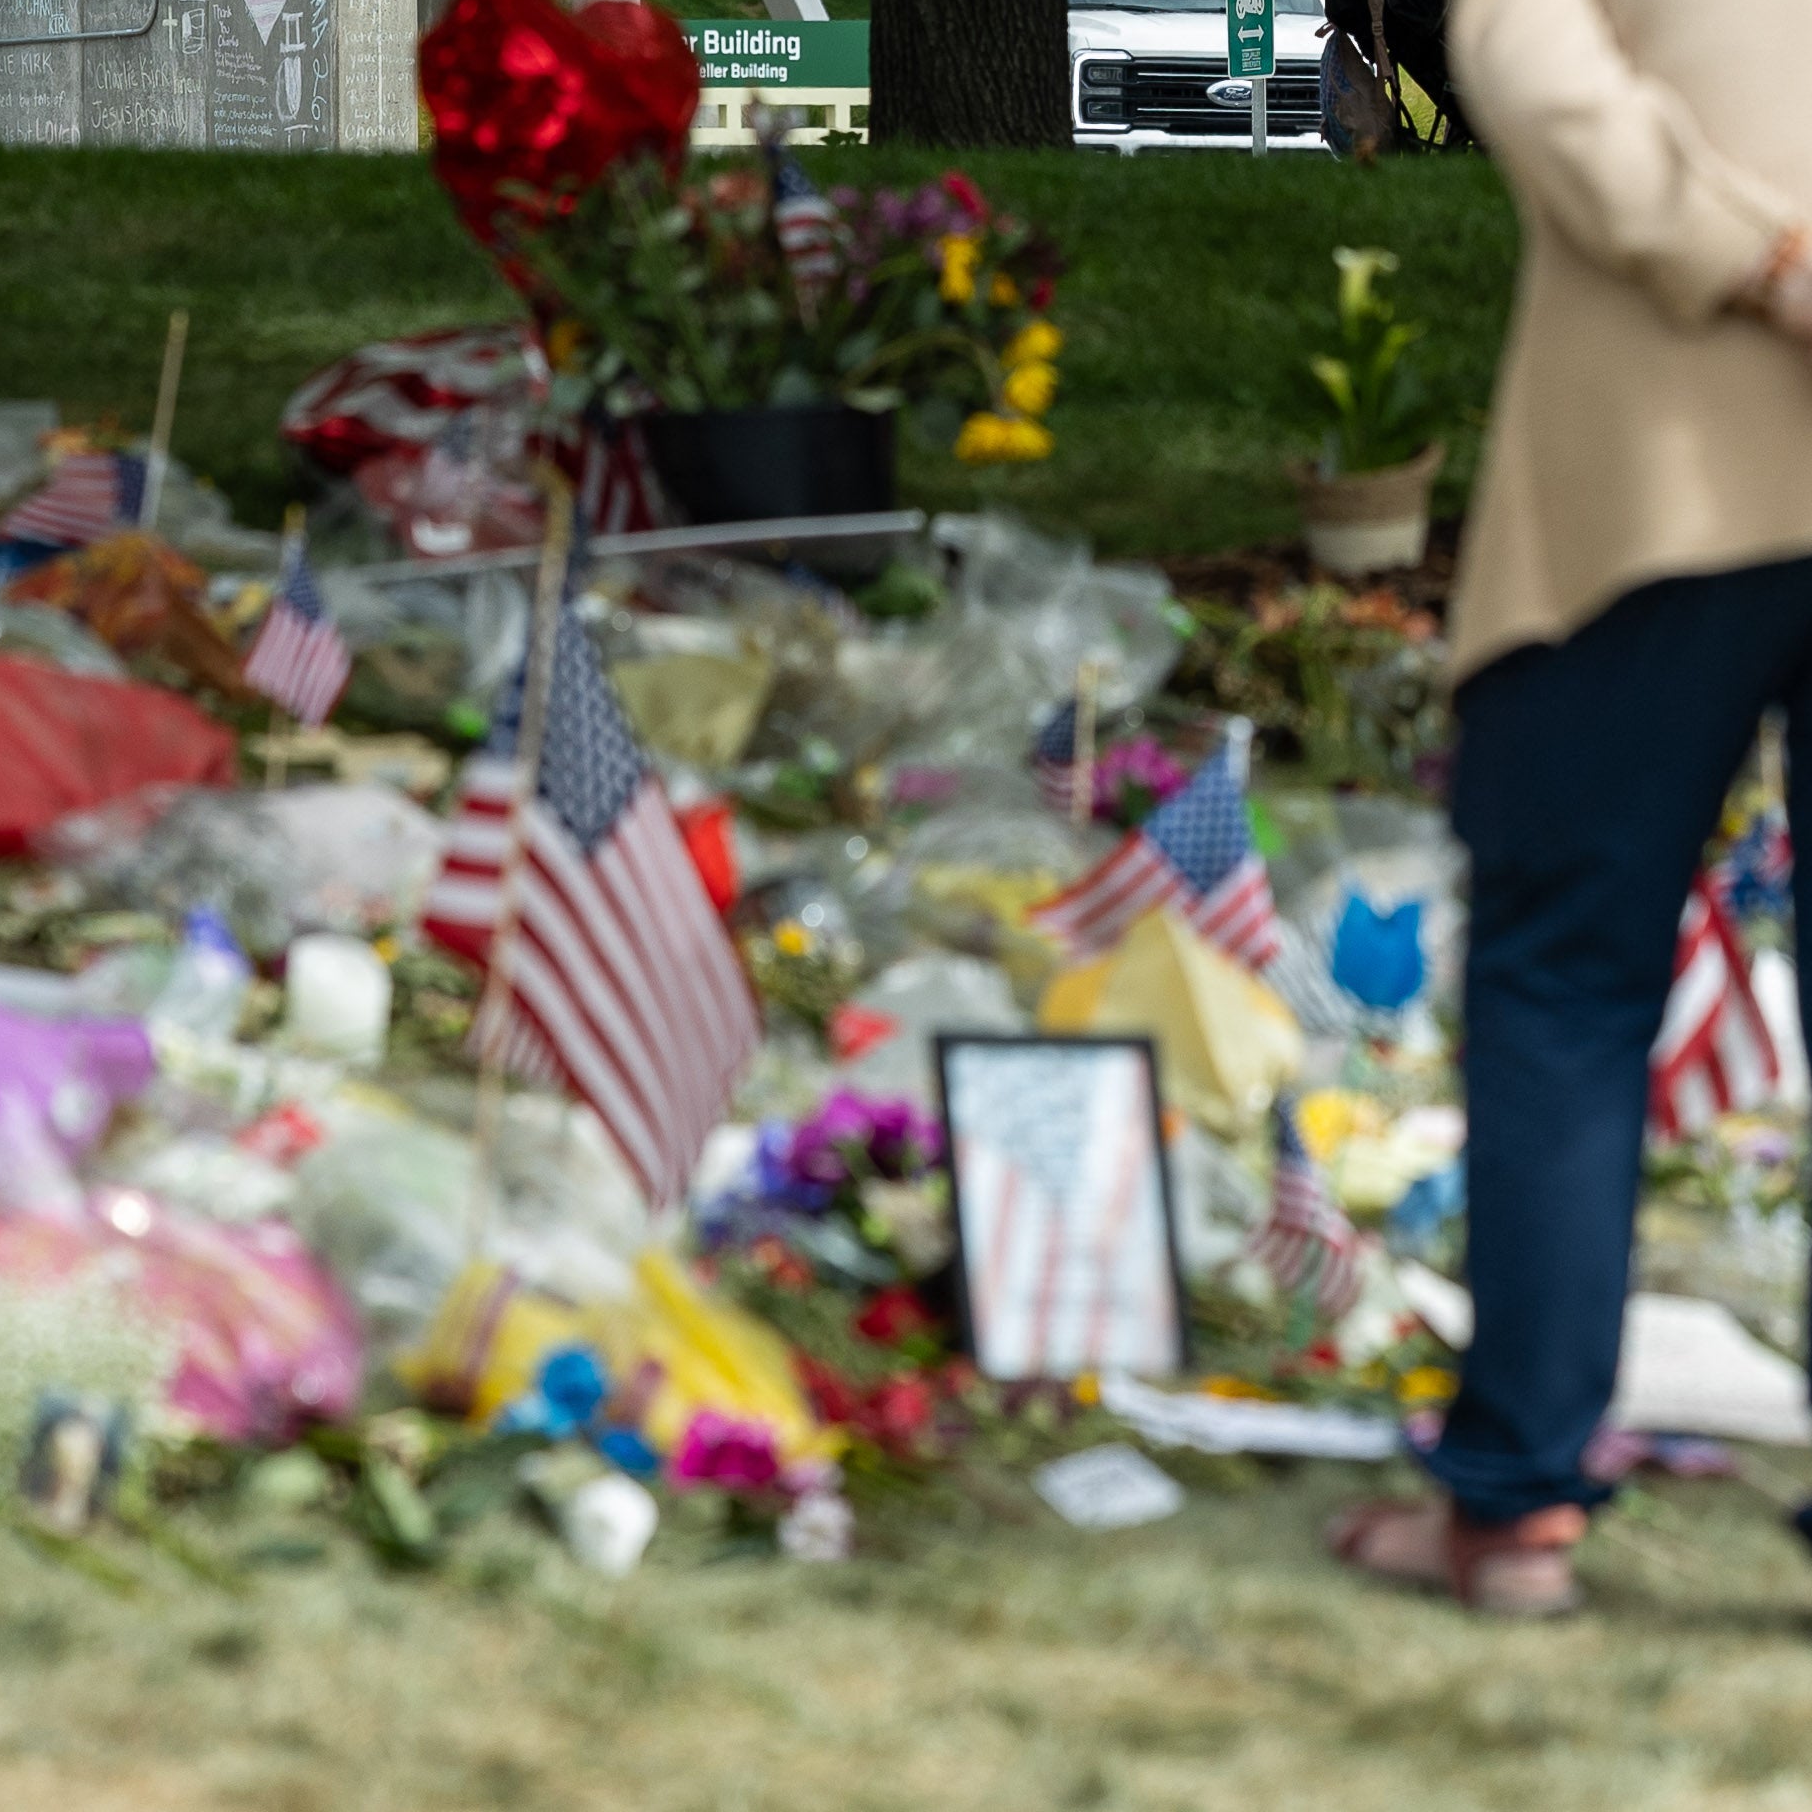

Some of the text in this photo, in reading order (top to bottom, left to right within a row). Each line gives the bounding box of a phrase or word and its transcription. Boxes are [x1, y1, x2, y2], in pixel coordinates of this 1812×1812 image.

[48, 15, 72, 36] KIRK
[704, 29, 801, 61] Building
[19, 51, 54, 77] KIRK
[720, 62, 788, 83] Building
[91, 99, 133, 130] Jesus
